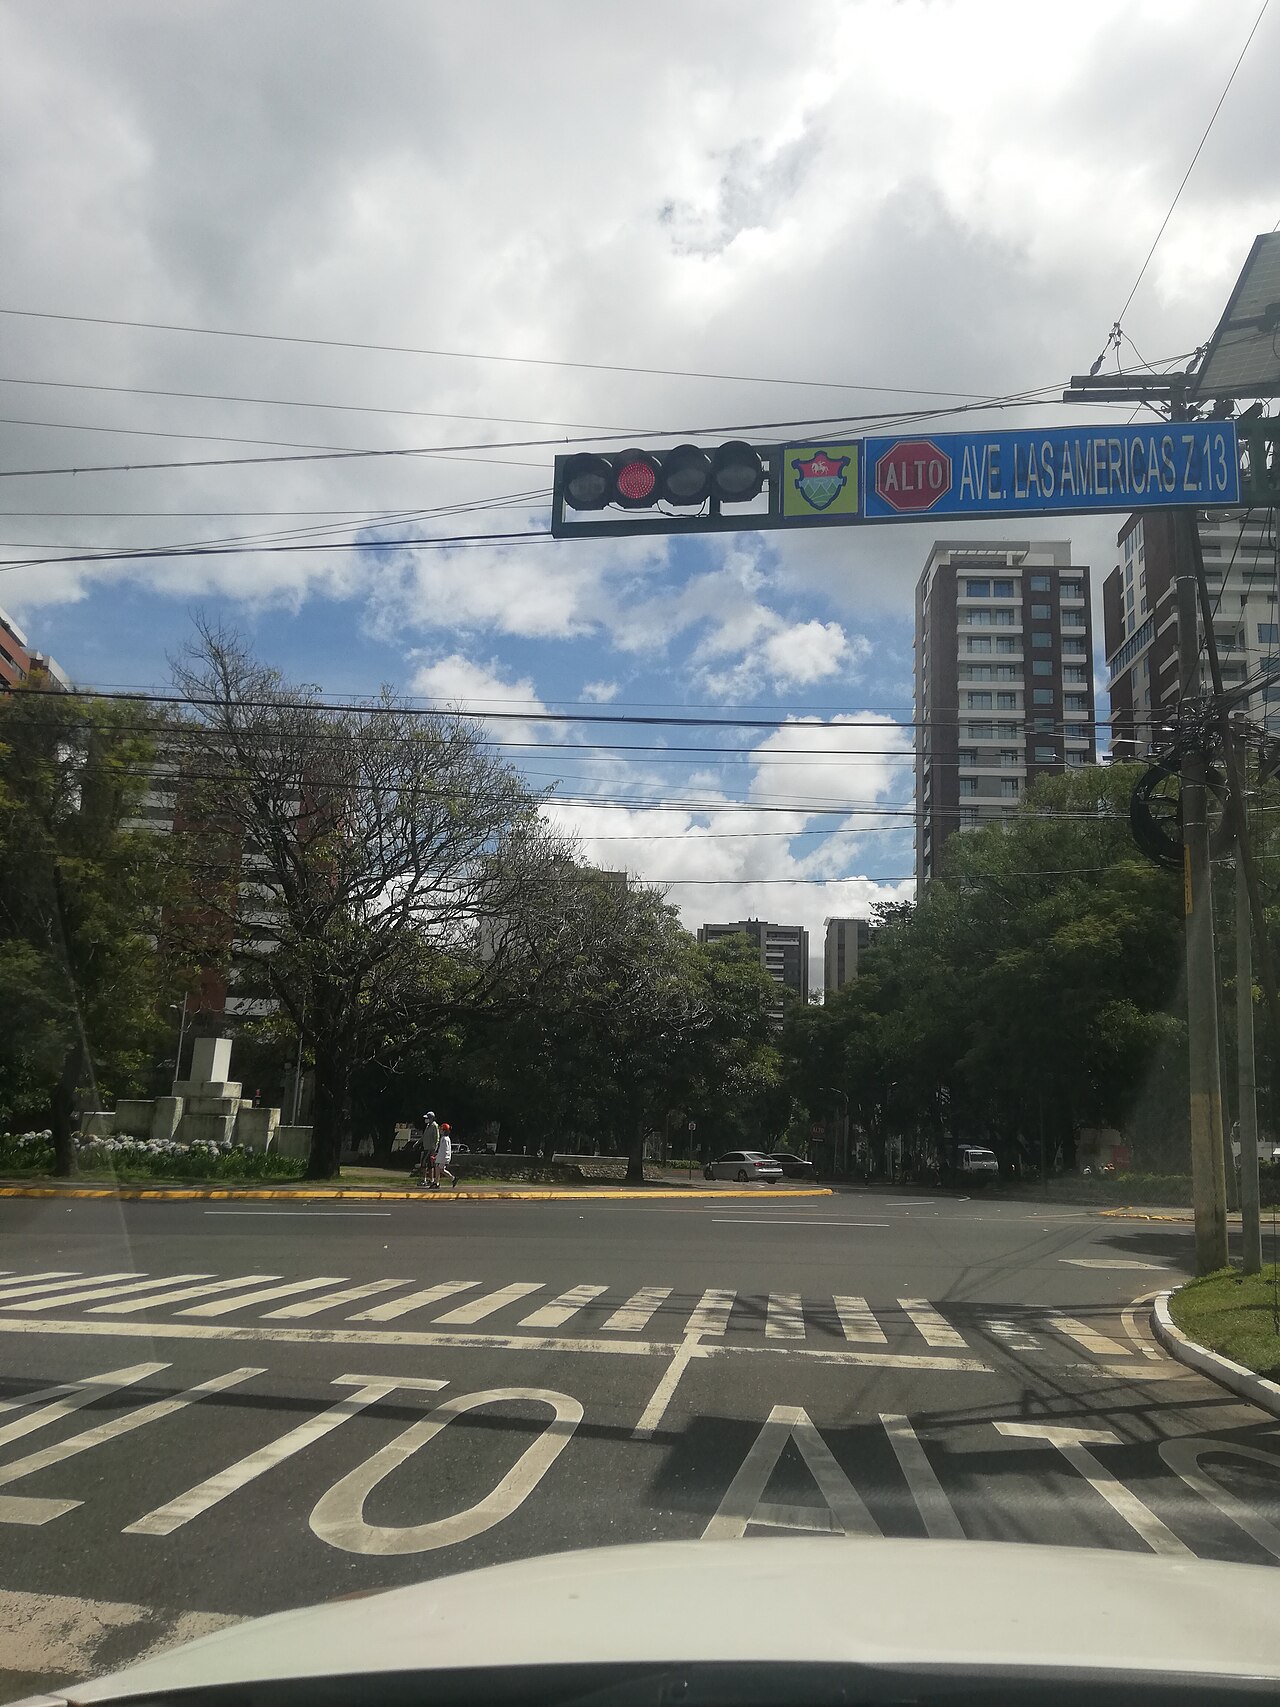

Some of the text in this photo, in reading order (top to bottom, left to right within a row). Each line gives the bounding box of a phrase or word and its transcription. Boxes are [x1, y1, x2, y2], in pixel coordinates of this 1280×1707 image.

[885, 459, 943, 491] ALTO
[959, 444, 1007, 500] AVE.
[1014, 441, 1055, 498] LAS
[1060, 435, 1176, 497] AMERICAS
